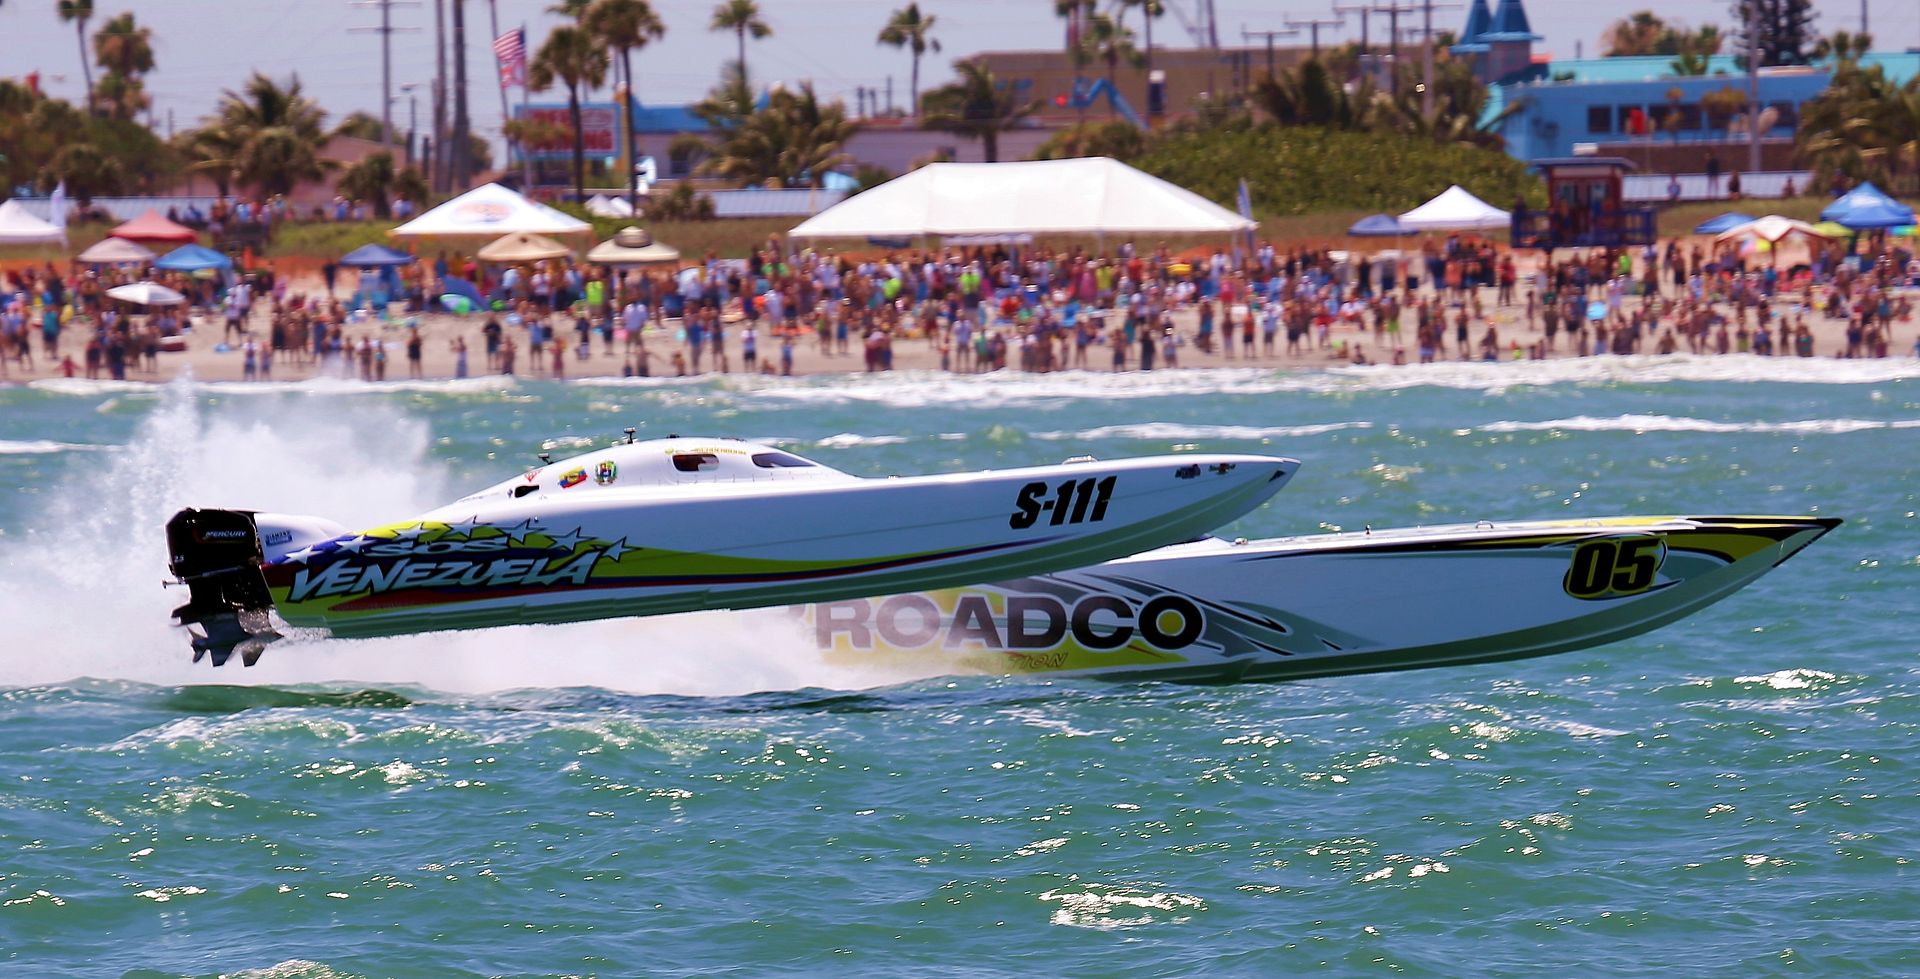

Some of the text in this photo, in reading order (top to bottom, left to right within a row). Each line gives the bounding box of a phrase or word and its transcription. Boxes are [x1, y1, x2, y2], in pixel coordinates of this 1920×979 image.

[1009, 476, 1117, 529] S-111
[205, 530, 247, 538] MERCURY
[363, 535, 510, 557] SOS
[288, 550, 602, 602] VENEZUELA
[1568, 537, 1661, 596] 05
[788, 594, 1203, 650] ROADCO
